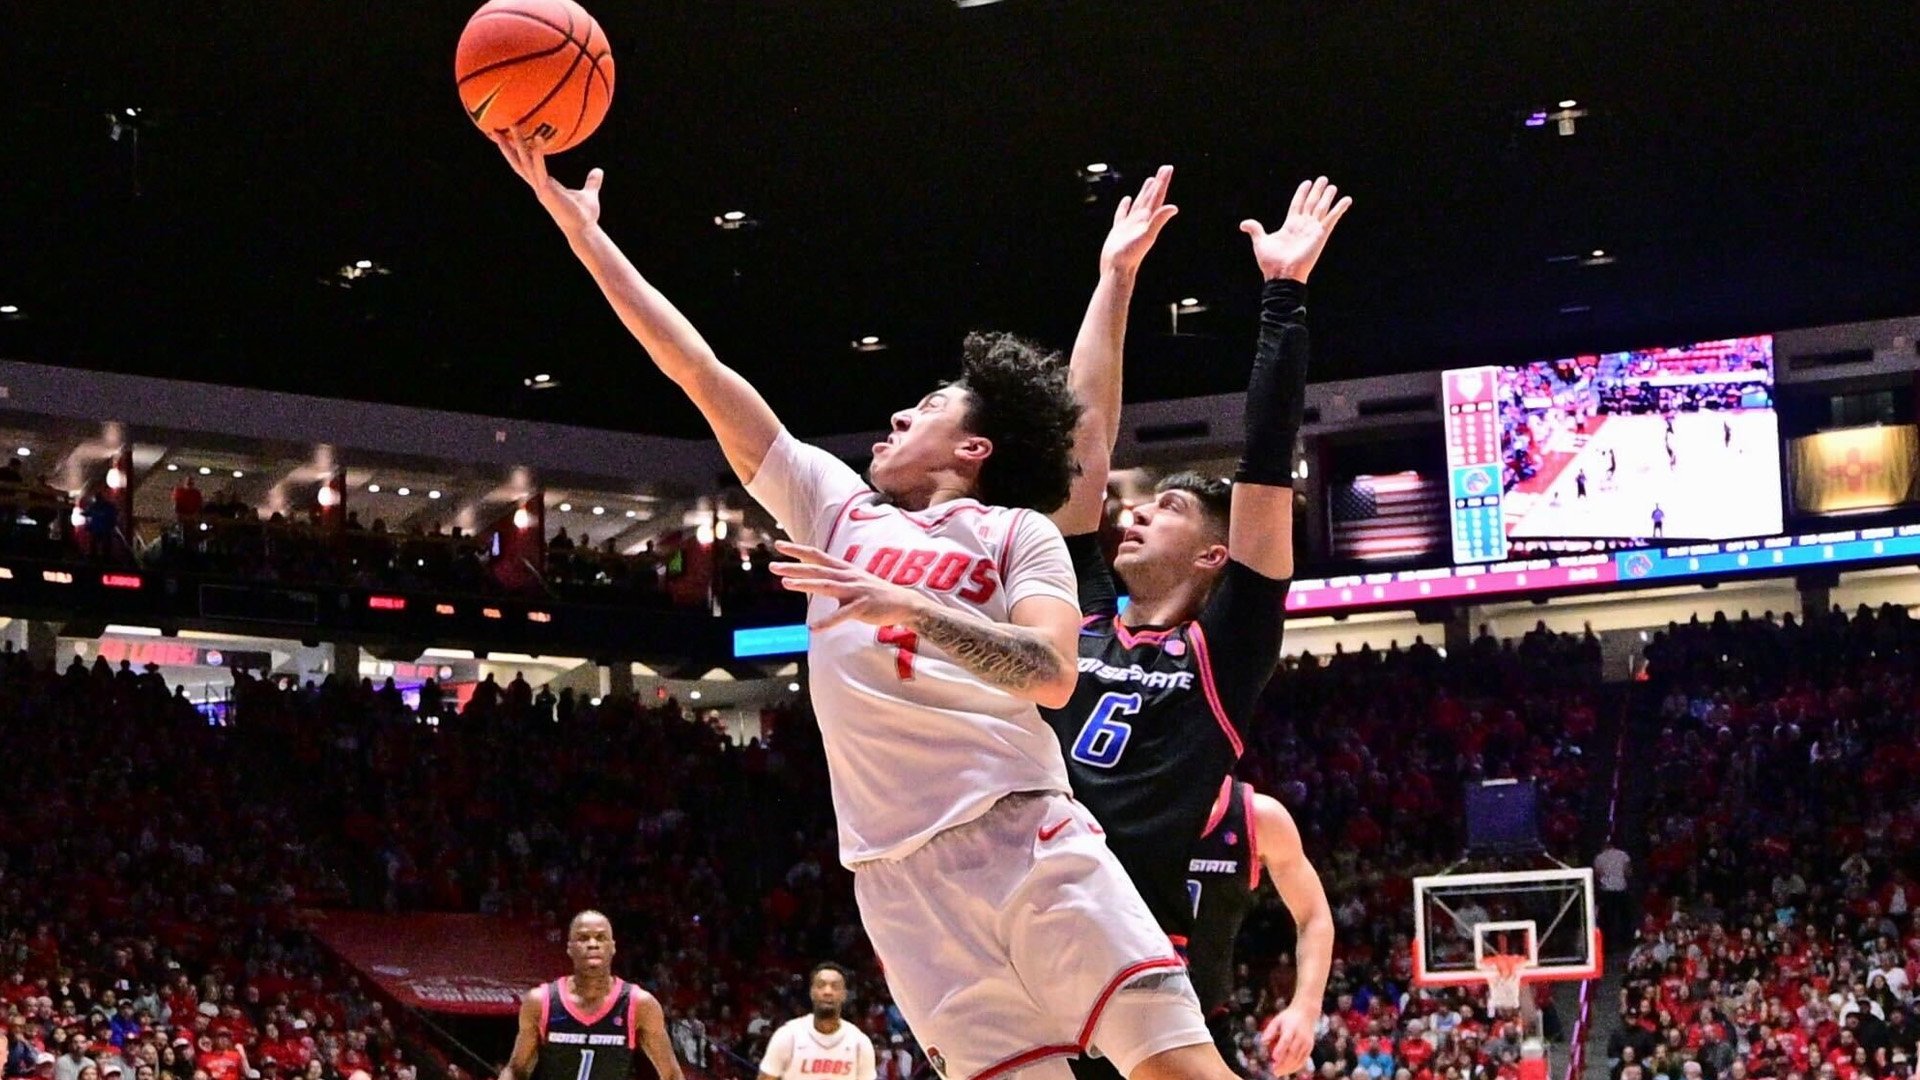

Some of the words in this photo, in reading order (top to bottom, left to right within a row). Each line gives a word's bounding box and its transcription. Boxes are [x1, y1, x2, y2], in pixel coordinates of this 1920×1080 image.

[1077, 657, 1129, 681] OISE
[1130, 664, 1194, 690] STATE
[1070, 691, 1142, 768] 6
[1188, 858, 1238, 873] STATE
[588, 1034, 626, 1046] STATE
[801, 1059, 853, 1075] LOBOS
